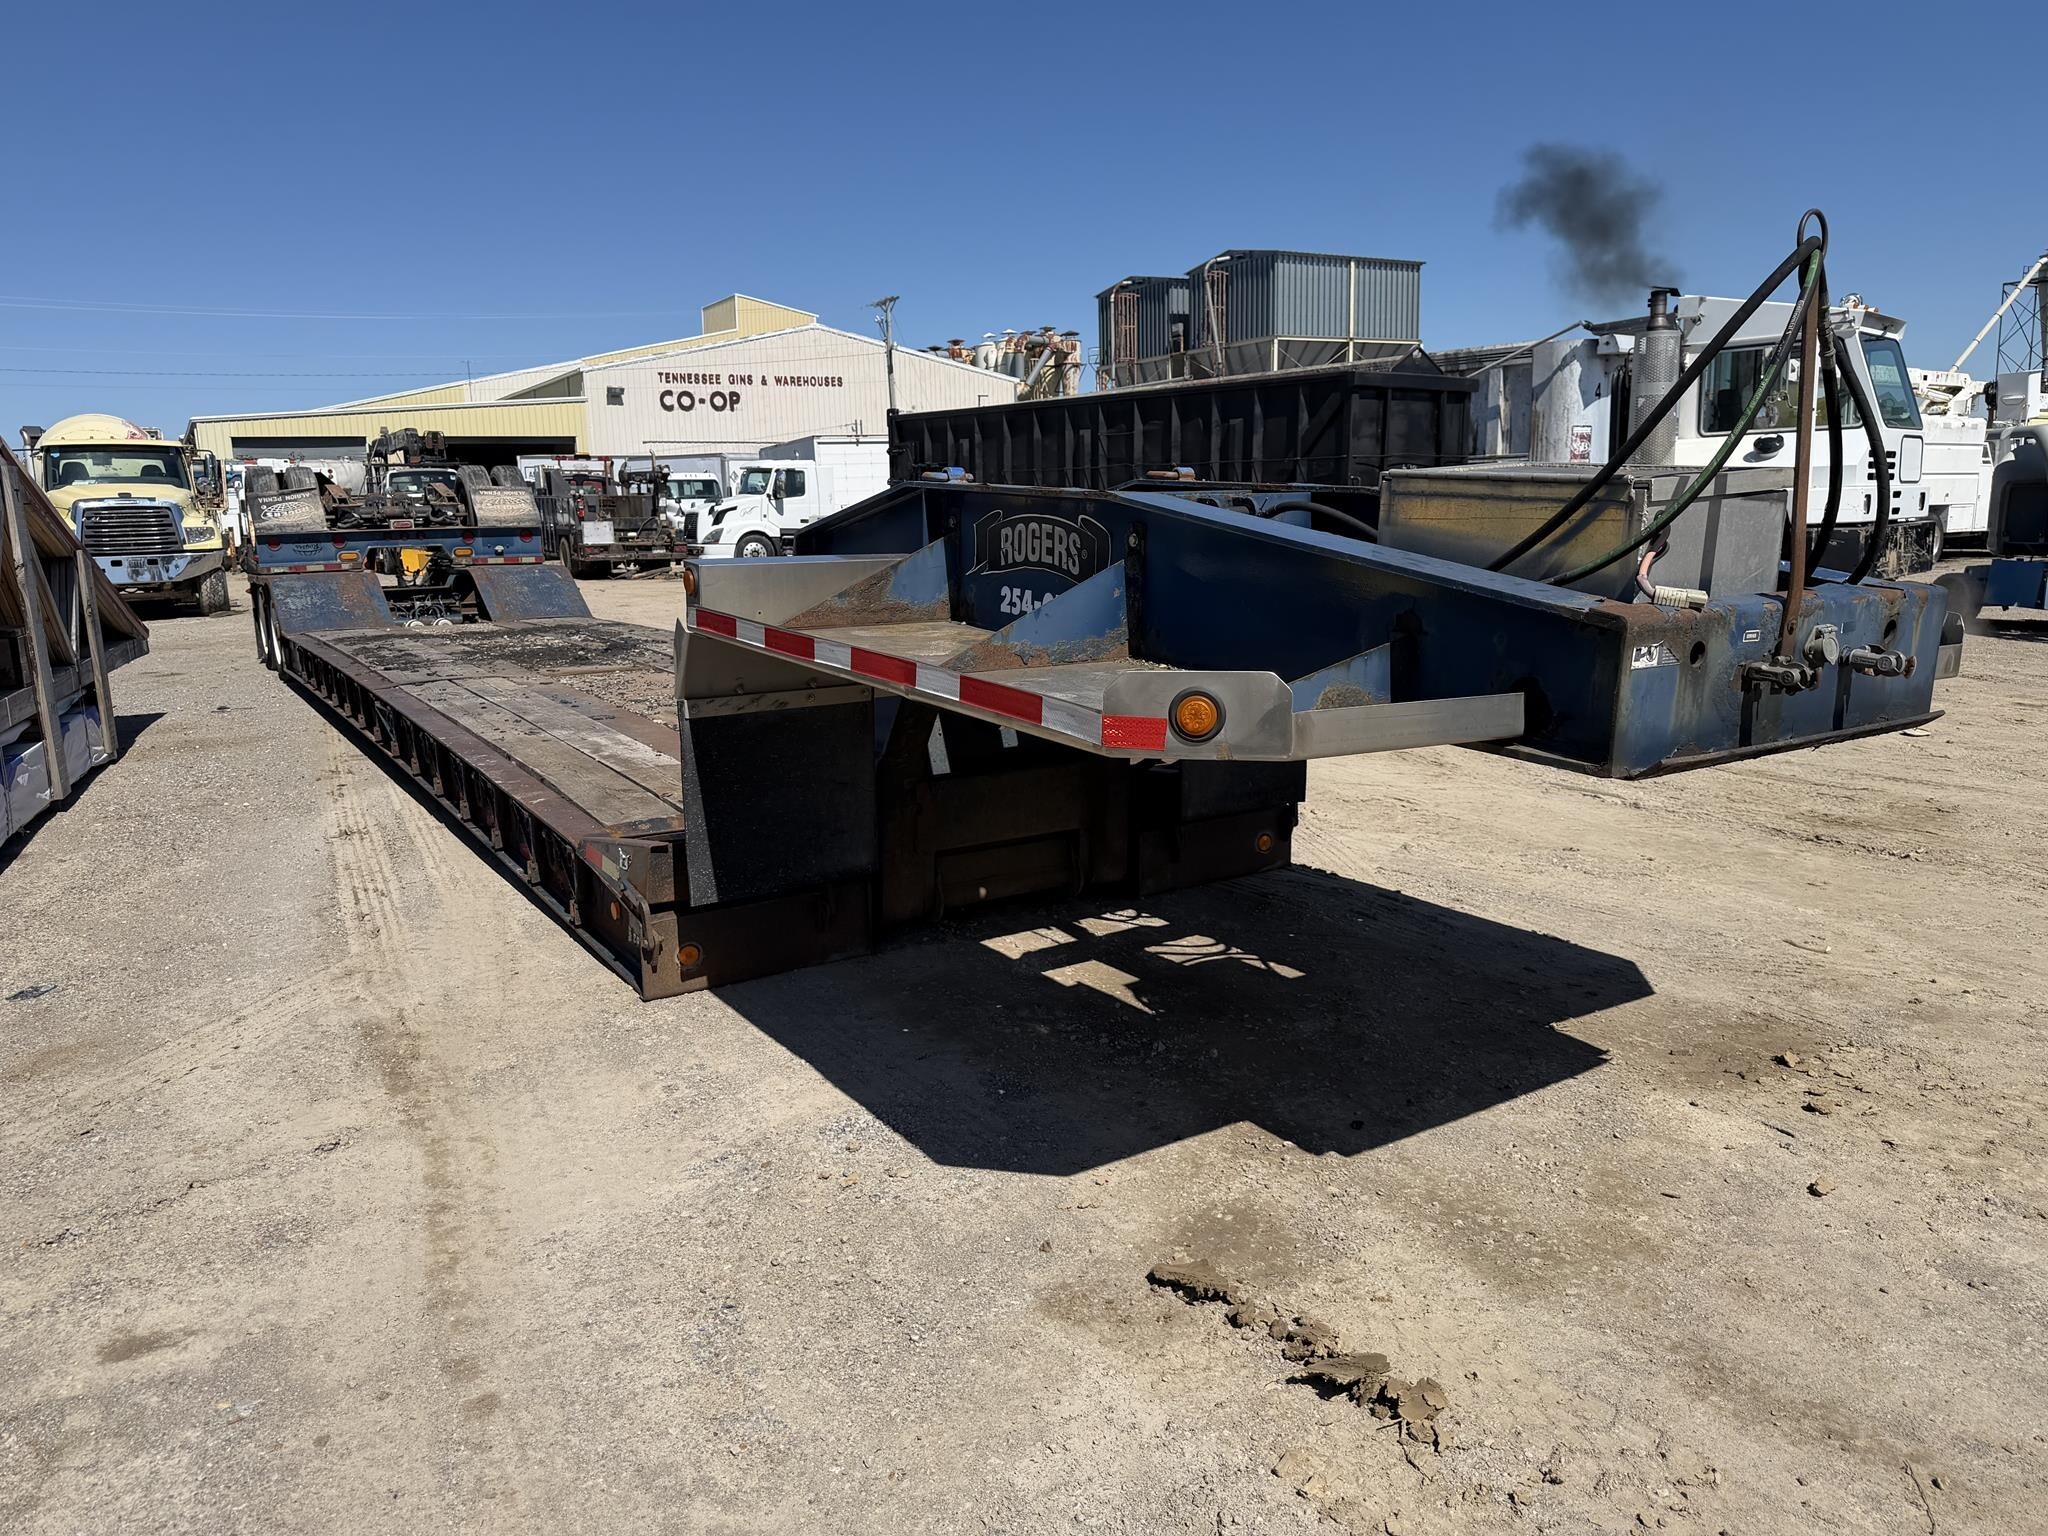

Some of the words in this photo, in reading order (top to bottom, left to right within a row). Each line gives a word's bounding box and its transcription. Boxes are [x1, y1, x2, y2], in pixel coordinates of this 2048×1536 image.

[658, 372, 721, 385] TENNESSEE
[728, 374, 753, 386] GINS
[761, 375, 768, 386] &
[774, 376, 843, 387] WAREHOUSES
[1594, 382, 1602, 400] 4
[659, 389, 741, 412] CO-OP
[1000, 522, 1081, 575] ROGERS
[1000, 585, 1060, 616] 254-
